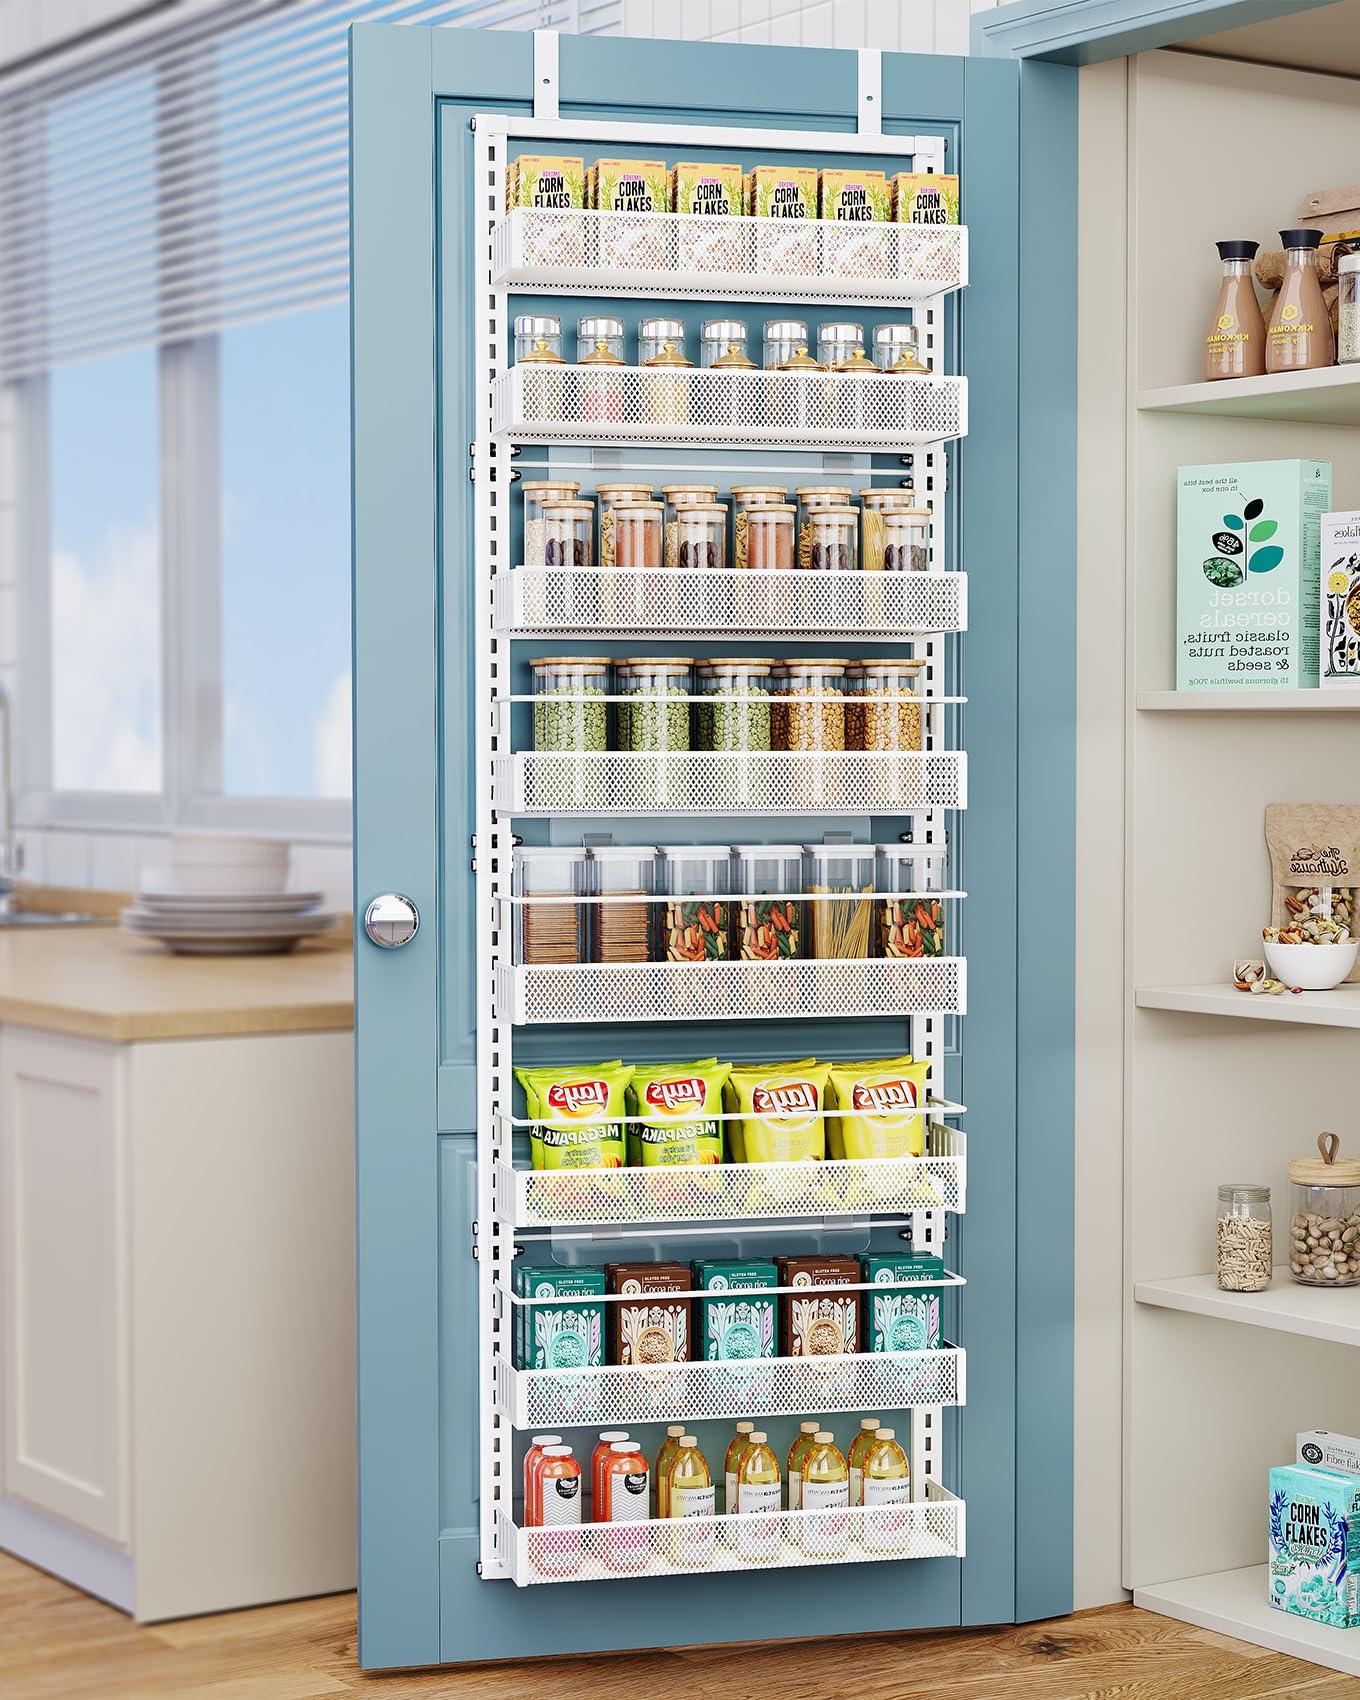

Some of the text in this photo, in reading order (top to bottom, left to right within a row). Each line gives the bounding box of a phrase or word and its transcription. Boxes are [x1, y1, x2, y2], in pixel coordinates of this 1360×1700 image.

[539, 176, 563, 193] CORN
[619, 181, 645, 196] CORN
[697, 184, 722, 200] CORN
[534, 193, 570, 208] FLAKES
[774, 187, 799, 203] CORN
[841, 190, 866, 206] CORN
[917, 194, 940, 209] CORN
[614, 197, 651, 212] FLAKES
[693, 200, 728, 215] FLAKES
[771, 203, 804, 218] FLAKES
[838, 206, 872, 221] FLAKES
[913, 209, 946, 224] FLAKES
[730, 1280, 767, 1289] Cocoa rice
[814, 1276, 850, 1286] Cocoa rice
[897, 1273, 934, 1282] Cocoa rice
[558, 1287, 594, 1297] Cocoa rice
[644, 1284, 681, 1293] Cocoa rice
[1326, 1454, 1345, 1466] Fibre
[1290, 1502, 1320, 1525] CORN
[1285, 1523, 1327, 1547] FLAKES
